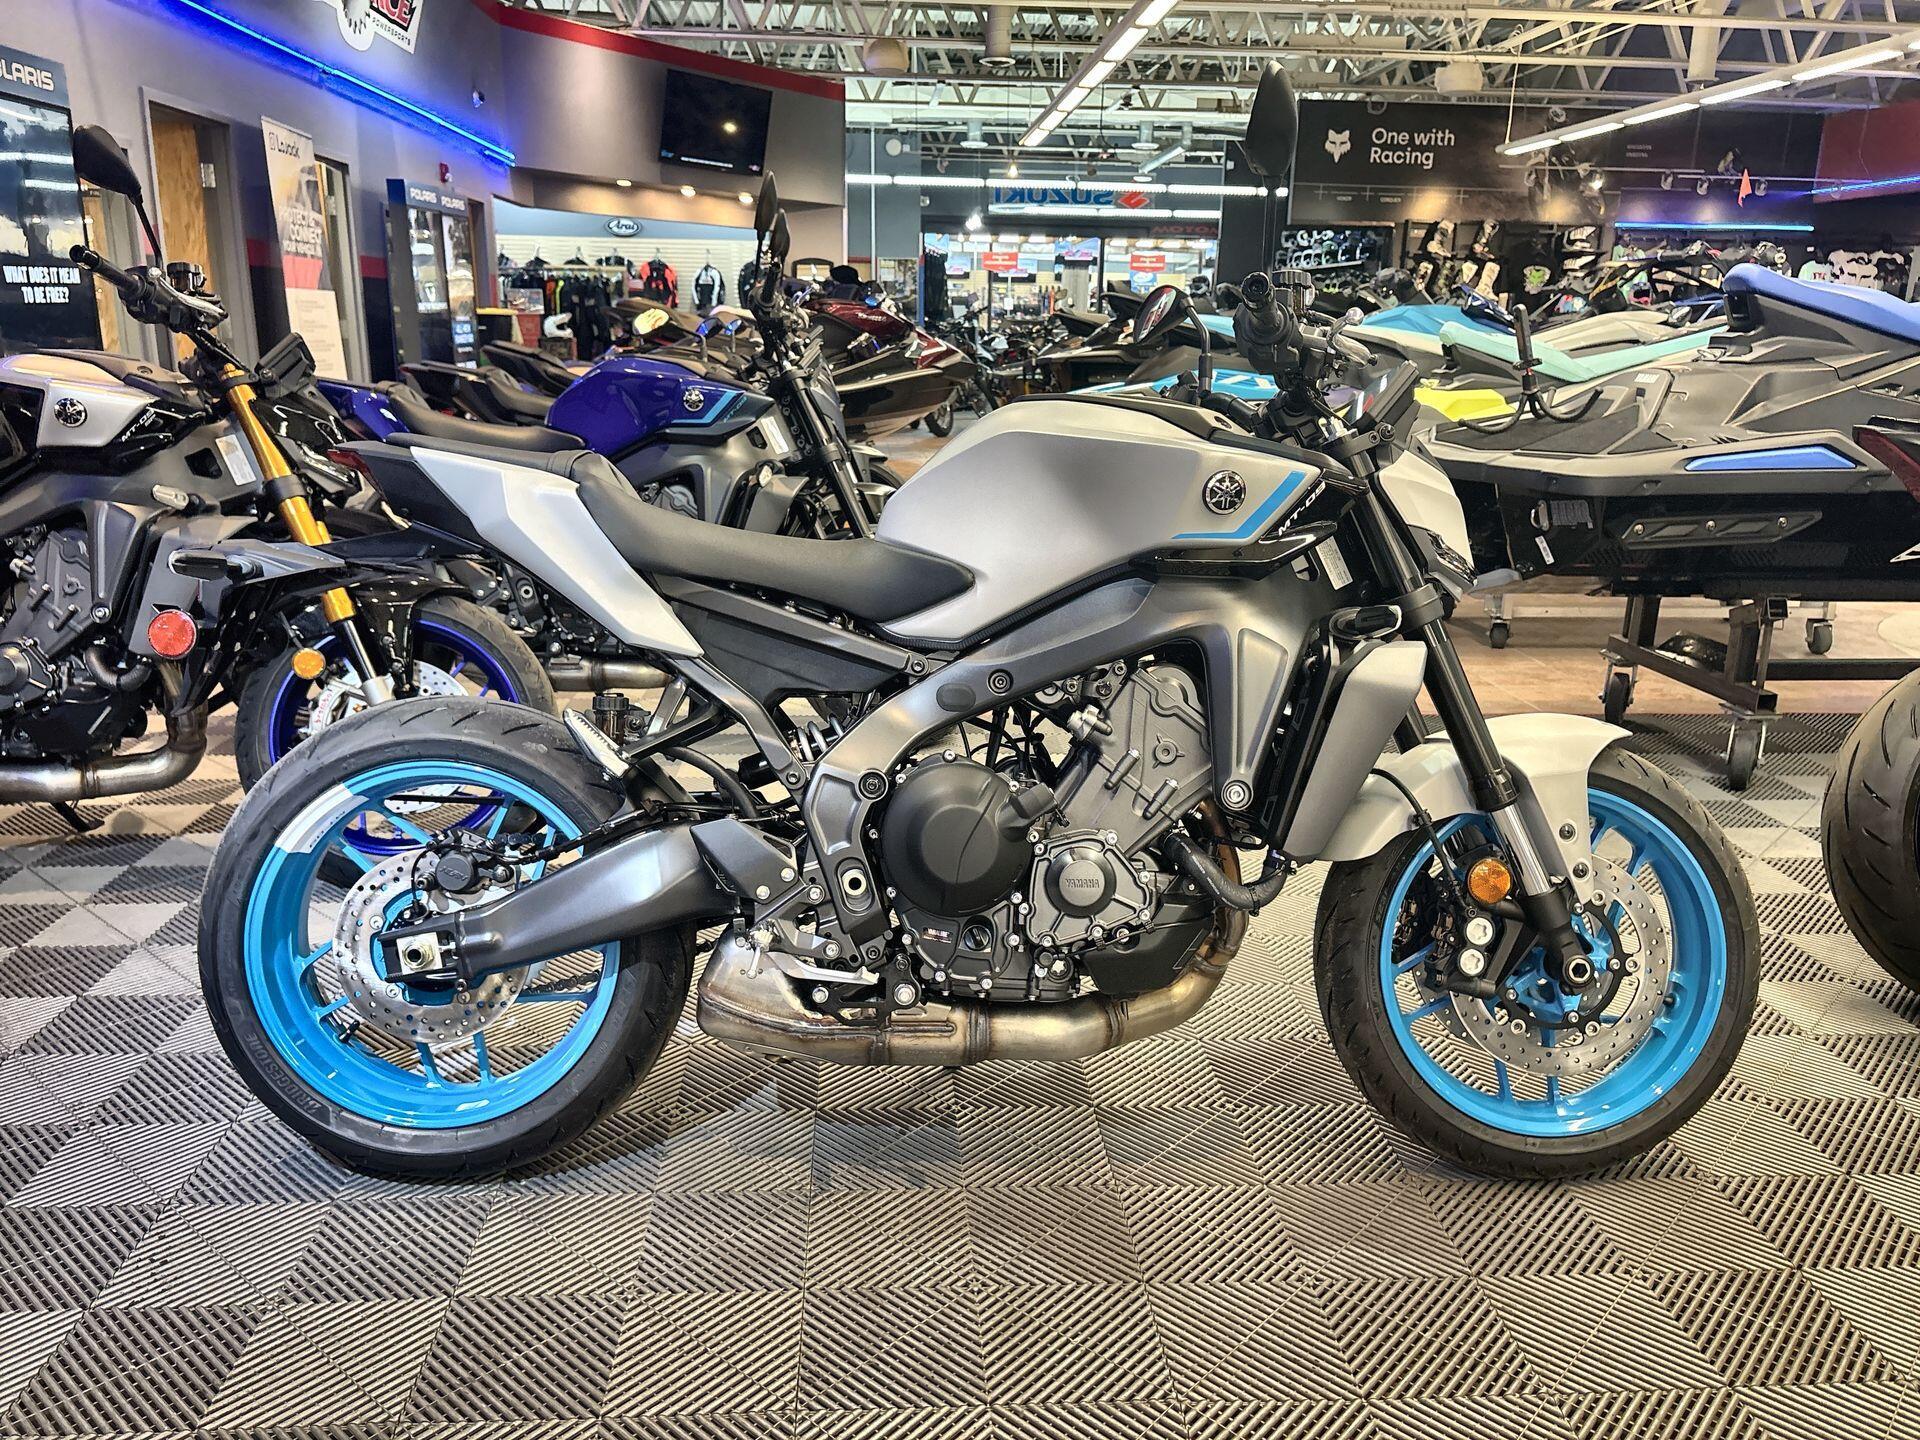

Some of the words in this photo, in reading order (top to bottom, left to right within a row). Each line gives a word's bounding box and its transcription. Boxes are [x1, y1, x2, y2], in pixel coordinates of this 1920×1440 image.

[371, 16, 411, 46] POWERSPORTS
[0, 58, 54, 91] LARIS
[1371, 127, 1410, 146] One
[1413, 128, 1456, 147] with
[1369, 147, 1435, 170] Racing
[409, 187, 438, 204] POLARIS
[2, 265, 28, 284] WHAT
[28, 266, 50, 284] DOES
[49, 267, 58, 284] IT
[58, 267, 81, 284] MEAN
[21, 286, 34, 304] TO
[33, 287, 46, 303] BE
[45, 287, 70, 303] FREE?
[121, 408, 155, 442] MT-09
[1278, 480, 1326, 537] MT-09
[1064, 878, 1100, 889] YAMAHA
[244, 1032, 323, 1113] BRIDGESTONE
